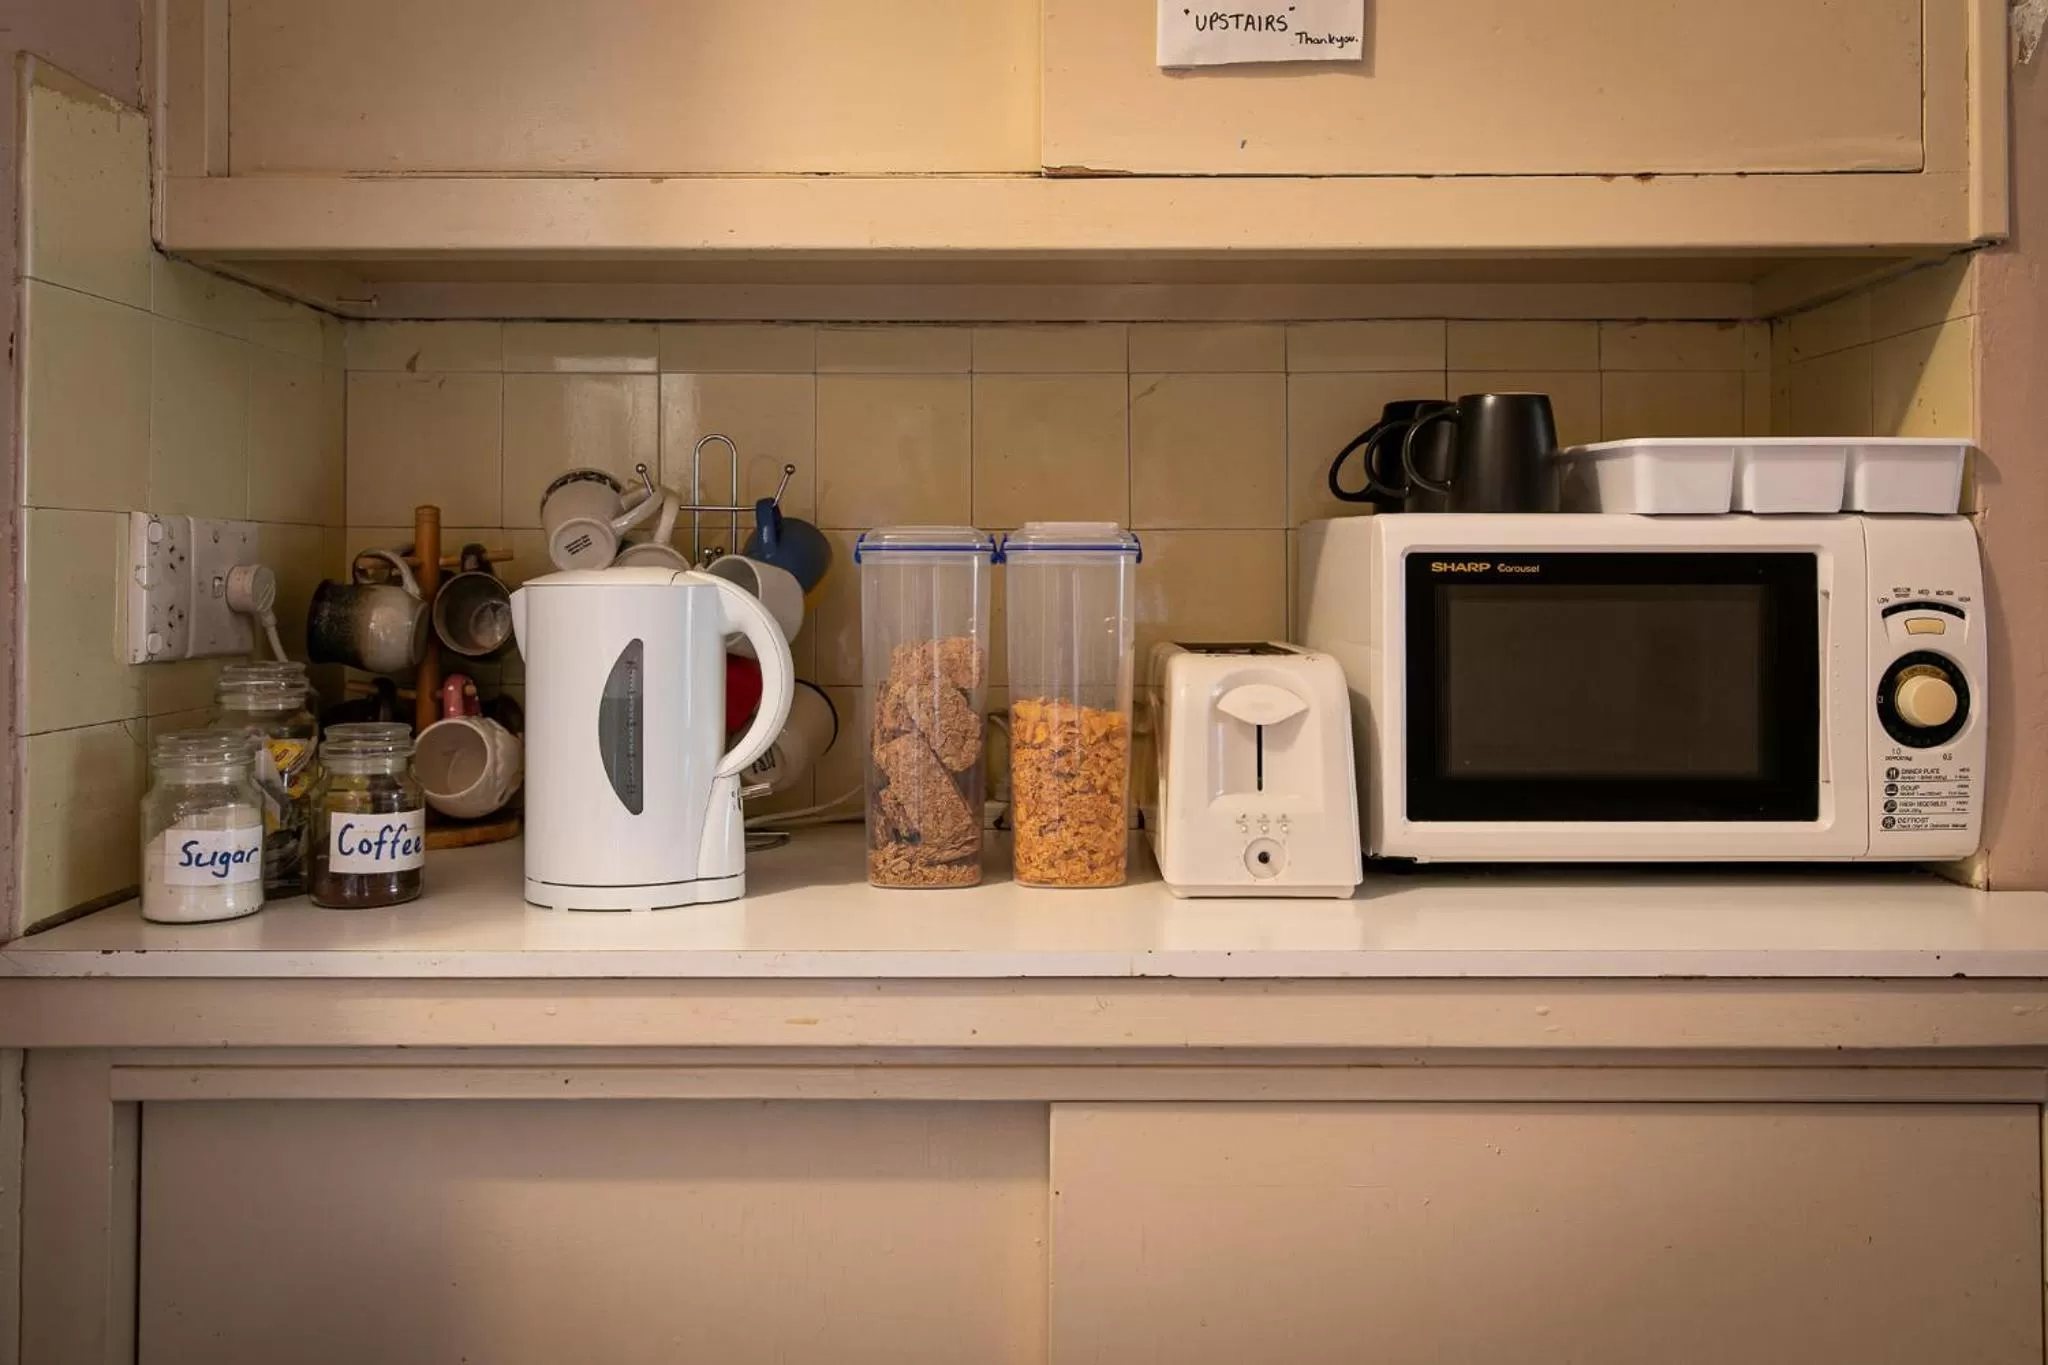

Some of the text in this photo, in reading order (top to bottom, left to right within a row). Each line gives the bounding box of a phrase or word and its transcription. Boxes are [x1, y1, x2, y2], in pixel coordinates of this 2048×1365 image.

[1431, 562, 1540, 573] SHARP Carousel
[179, 840, 259, 878] Sugar
[338, 823, 422, 860] Coffee
